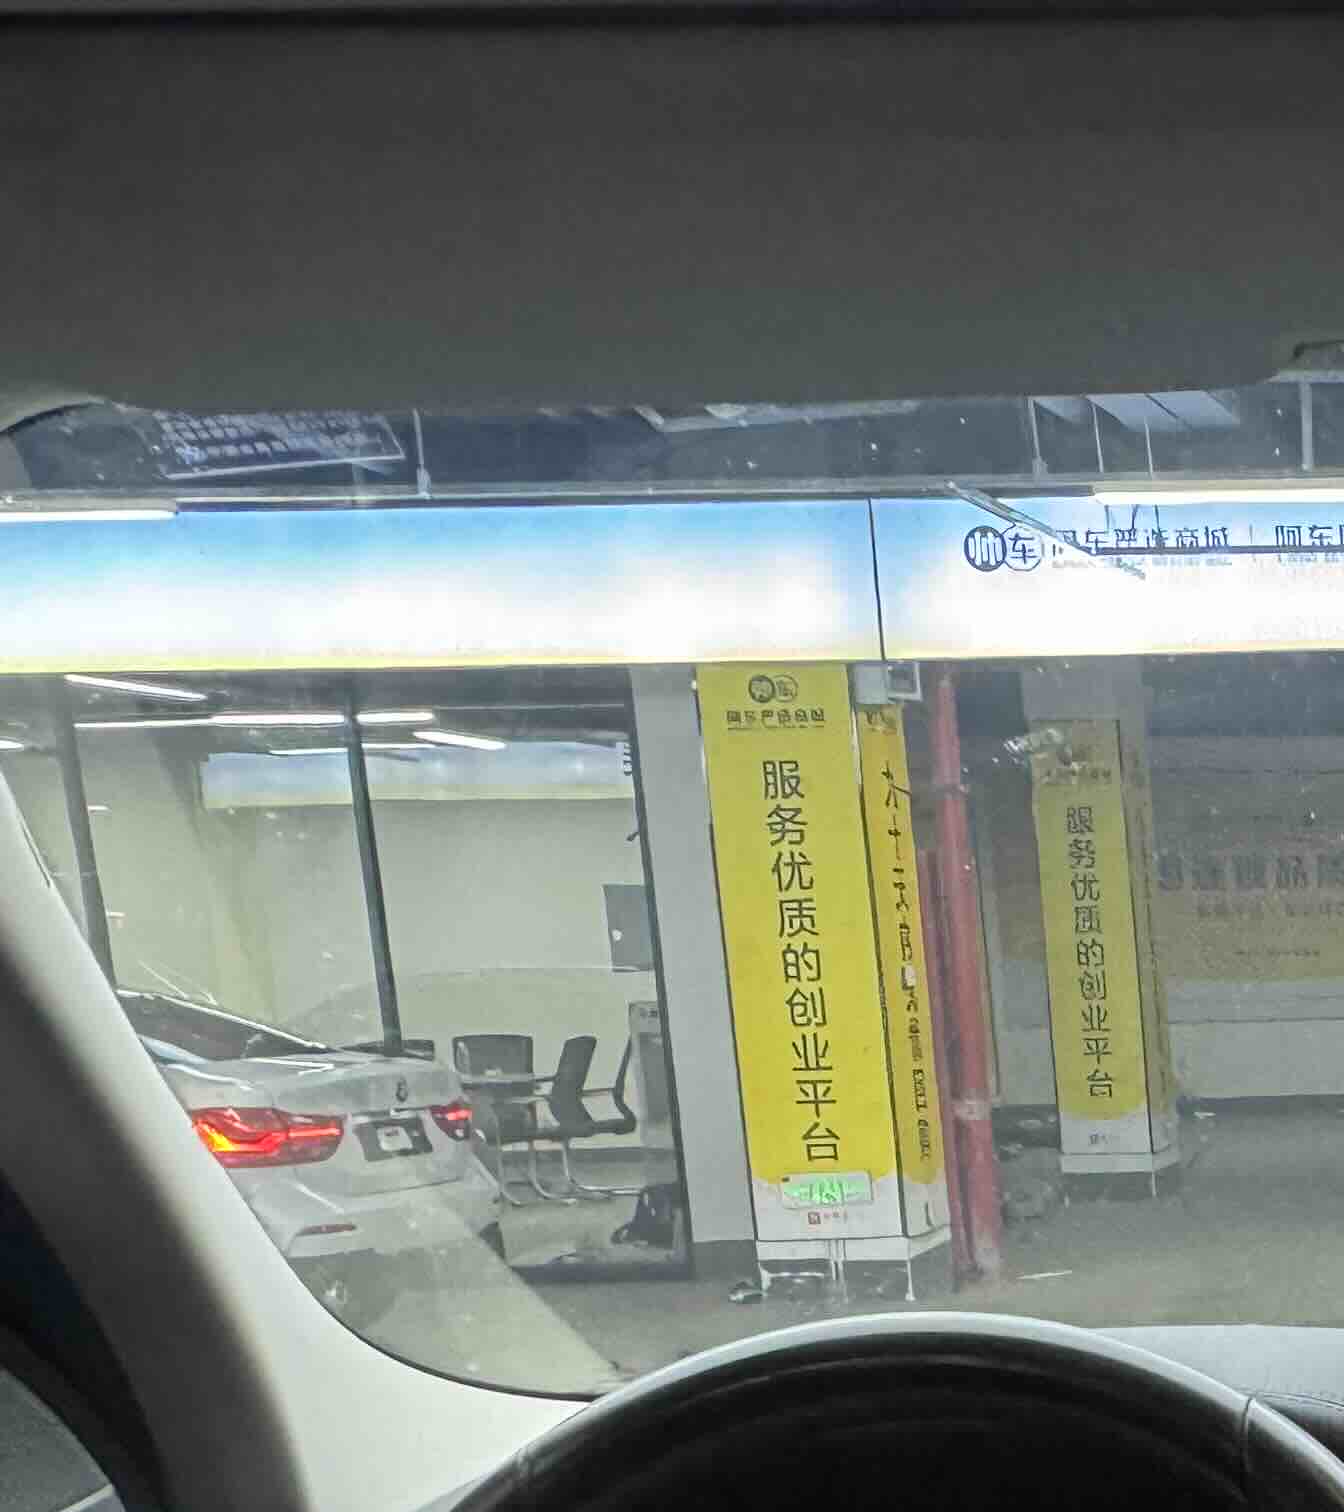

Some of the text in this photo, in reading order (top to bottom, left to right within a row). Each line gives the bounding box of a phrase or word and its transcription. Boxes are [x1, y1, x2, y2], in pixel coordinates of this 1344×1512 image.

[762, 759, 841, 1162] 服务优质的创业平台
